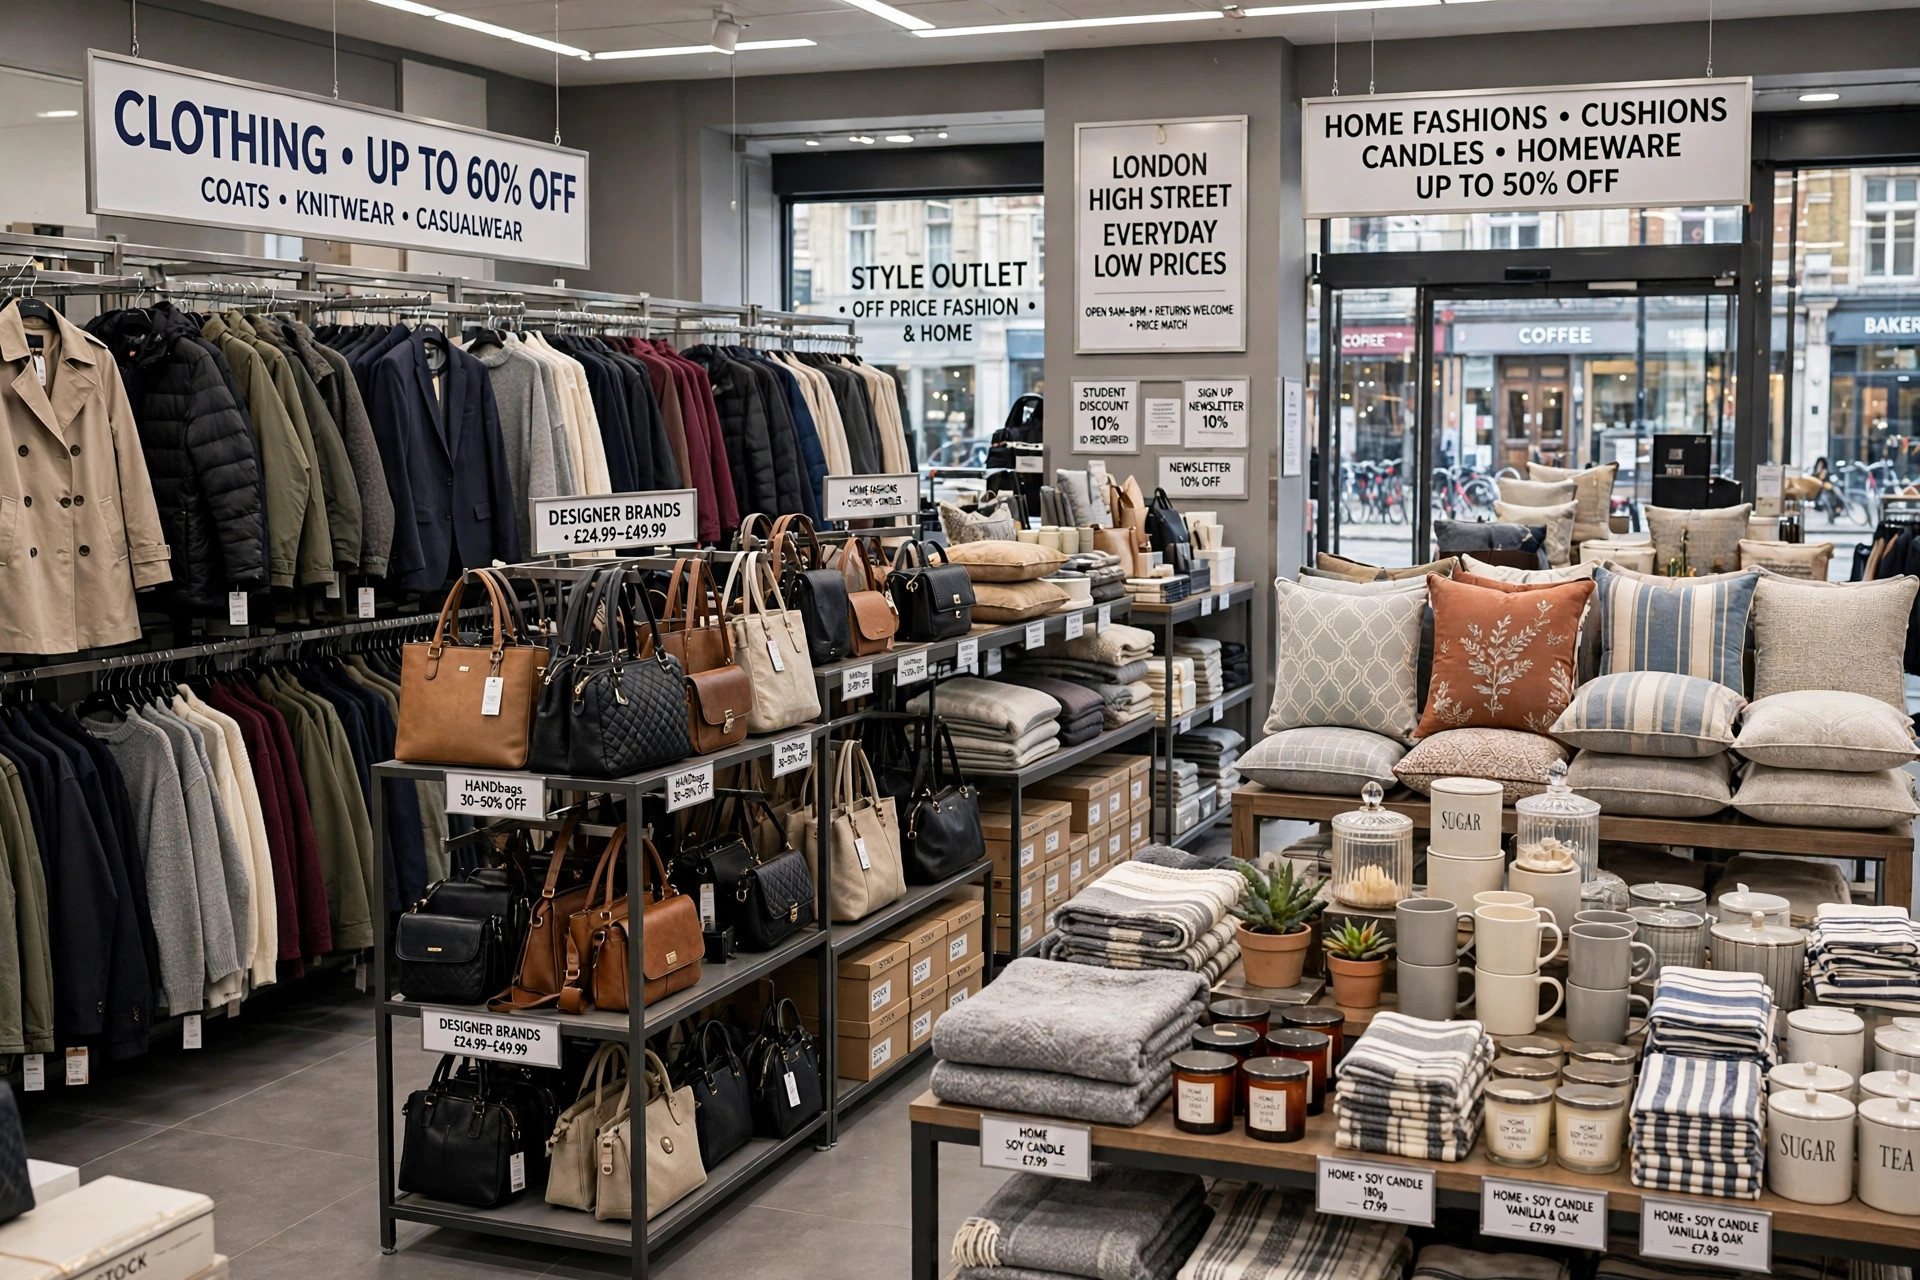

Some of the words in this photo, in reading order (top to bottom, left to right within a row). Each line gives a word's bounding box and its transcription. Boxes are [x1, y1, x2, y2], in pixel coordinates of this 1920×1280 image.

[1324, 112, 1404, 138] HOME
[1413, 105, 1548, 135] FASHIONS
[1581, 97, 1727, 128] CUSHIONS
[114, 89, 327, 175] CLOTHING
[367, 135, 409, 186] UP
[419, 146, 457, 195] TO
[467, 156, 522, 206] 60%
[529, 167, 576, 213] OFF
[1362, 140, 1484, 169] CANDLES
[1517, 133, 1681, 163] HOMEWARE
[1113, 152, 1208, 179] LONDON
[1416, 174, 1451, 199] UP
[1459, 172, 1494, 197] TO
[1502, 171, 1558, 197] 50%
[1566, 169, 1619, 194] OFF
[1089, 186, 1143, 211] HIGH
[1150, 184, 1232, 210] STREET
[201, 176, 269, 210] COATS
[296, 189, 395, 226] KNITWEAR
[416, 207, 523, 242] CASUALWEAR
[1104, 219, 1218, 247] EVERYDAY
[1094, 253, 1142, 277] LOW
[1150, 251, 1226, 276] PRICES
[852, 263, 924, 290] STYLE
[932, 261, 1027, 288] OUTLET
[853, 300, 885, 318] OFF
[890, 299, 937, 317] PRICE
[943, 297, 1018, 316] FASHION
[1085, 307, 1107, 317] OPEN
[1155, 305, 1191, 316] RETURNS
[1193, 304, 1234, 315] WELCOME
[903, 325, 915, 342] &
[921, 323, 972, 341] HOME
[1136, 320, 1159, 331] PRICE
[1161, 320, 1188, 330] MATCH
[1518, 327, 1592, 344] COFFEE
[1083, 387, 1126, 398] STUDENT
[1198, 388, 1218, 398] SIGN
[1221, 388, 1233, 397] UP
[1080, 401, 1129, 412] DISCOUNT
[1189, 401, 1244, 412] NEWSLETTER
[1090, 415, 1119, 431] 10%
[1203, 415, 1228, 429] 10%
[1080, 435, 1088, 445] ID
[1090, 435, 1128, 445] REQUIRED
[1169, 462, 1231, 473] NEWSLETTER
[1180, 476, 1199, 488] 10%
[1202, 476, 1221, 487] OFF
[548, 506, 621, 527] DESIGNER
[625, 502, 681, 520] BRANDS
[465, 779, 523, 797] HANDbags
[505, 798, 527, 811] OFF
[1441, 811, 1481, 831] SUGAR
[440, 1018, 493, 1036] DESIGNER
[496, 1024, 541, 1041] BRANDS
[1020, 1127, 1047, 1140] HOME
[1006, 1139, 1024, 1151] SOY
[1027, 1142, 1065, 1156] CANDLE
[1780, 1133, 1836, 1162] SUGAR
[1023, 1155, 1048, 1167] £7.99
[1879, 1145, 1914, 1172] TEA
[1328, 1168, 1355, 1181] HOME
[1365, 1173, 1384, 1184] SOY
[1386, 1176, 1423, 1190] CANDLE
[1363, 1187, 1384, 1200] 180g
[1493, 1190, 1522, 1203] HOME
[1532, 1195, 1551, 1207] SOY
[1555, 1198, 1594, 1212] CANDLE
[1363, 1200, 1388, 1212] £7.99
[1506, 1204, 1546, 1220] VANILLA
[1548, 1210, 1555, 1221] &
[1558, 1212, 1579, 1224] OAK
[1529, 1222, 1556, 1235] £7.99
[1654, 1210, 1684, 1223] HOME
[1695, 1215, 1715, 1227] SOY
[1718, 1218, 1759, 1233] CANDLE
[1668, 1225, 1709, 1240] VANILLA
[1711, 1231, 1719, 1242] &
[1721, 1232, 1743, 1245] OAK
[1691, 1244, 1719, 1256] £7.99
